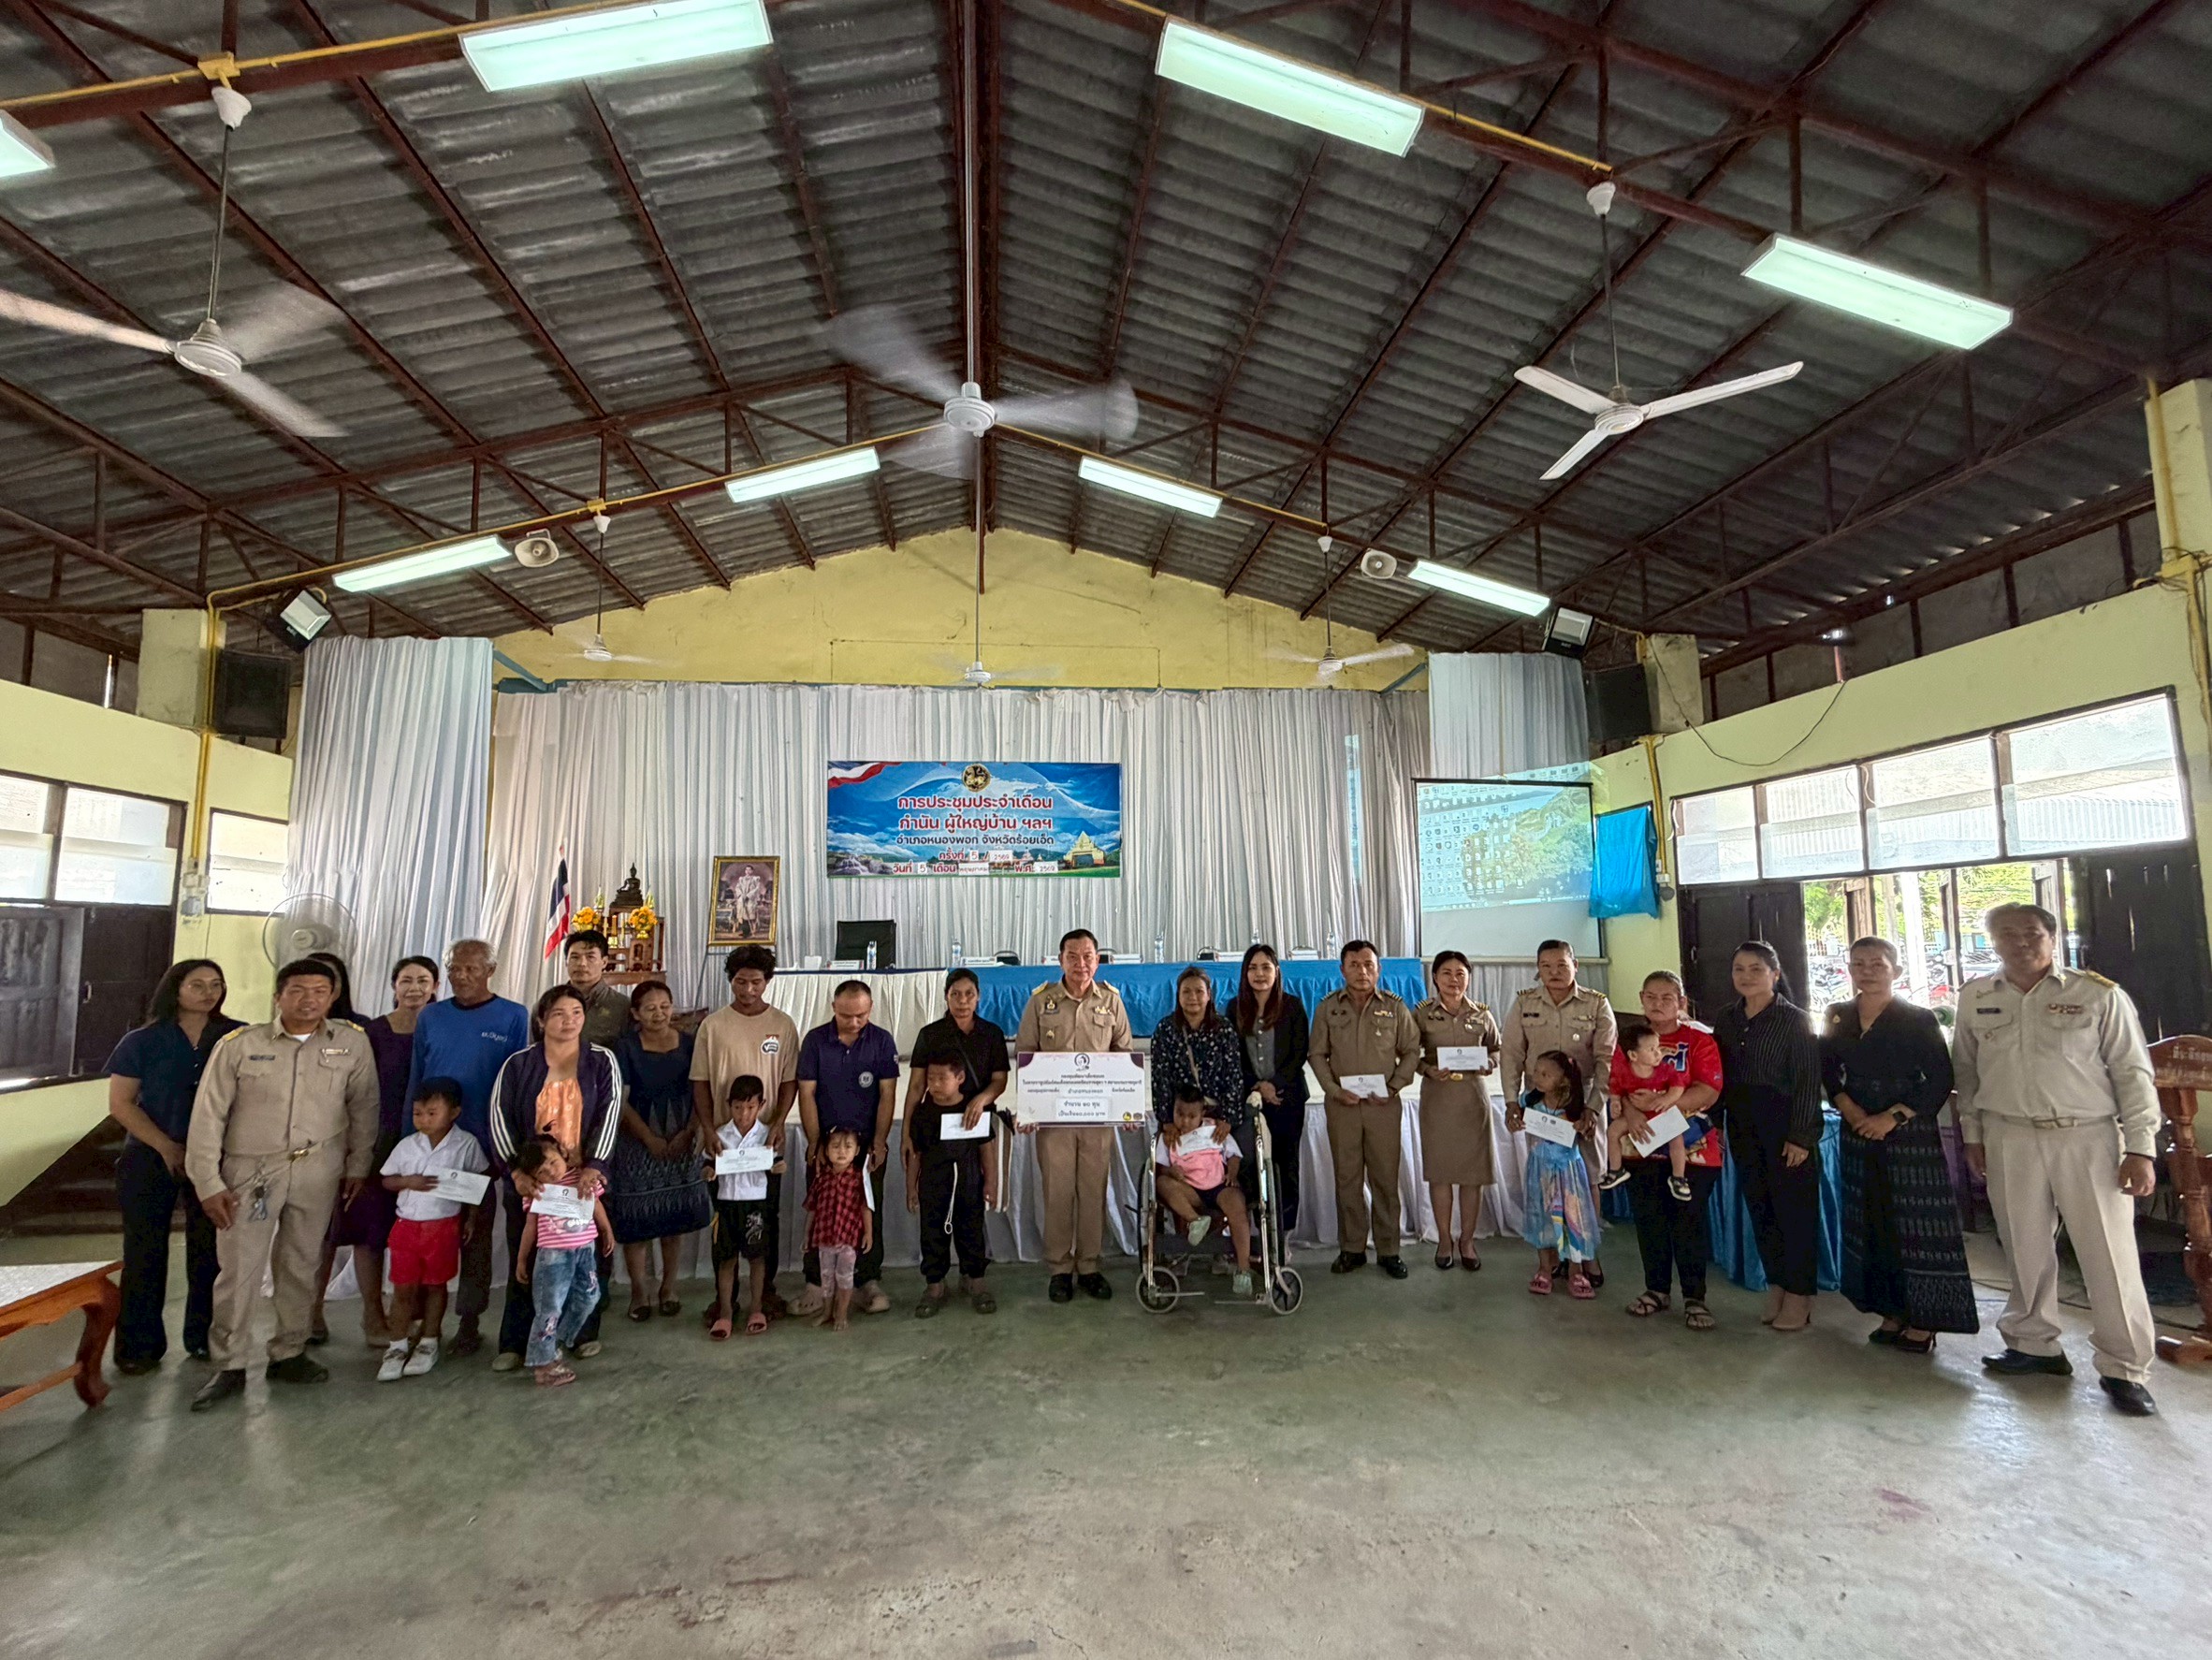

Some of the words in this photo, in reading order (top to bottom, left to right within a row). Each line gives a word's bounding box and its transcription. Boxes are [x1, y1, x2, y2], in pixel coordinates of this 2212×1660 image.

[898, 793, 1052, 811] การประชุมประจำเดือน
[899, 814, 939, 829] กำนัน
[945, 813, 1017, 833] ผู้ใหญ่บ้าน
[1022, 818, 1052, 829] ฯลฯ
[896, 834, 979, 845] อำเภอหนองพอก
[982, 833, 1055, 845] จังหวัดร้อยเอ็ด
[939, 847, 965, 860] ครั้งที่
[971, 851, 978, 860] 5
[893, 859, 912, 873] วันที่
[919, 864, 926, 872] 5
[933, 861, 957, 873] เดือน
